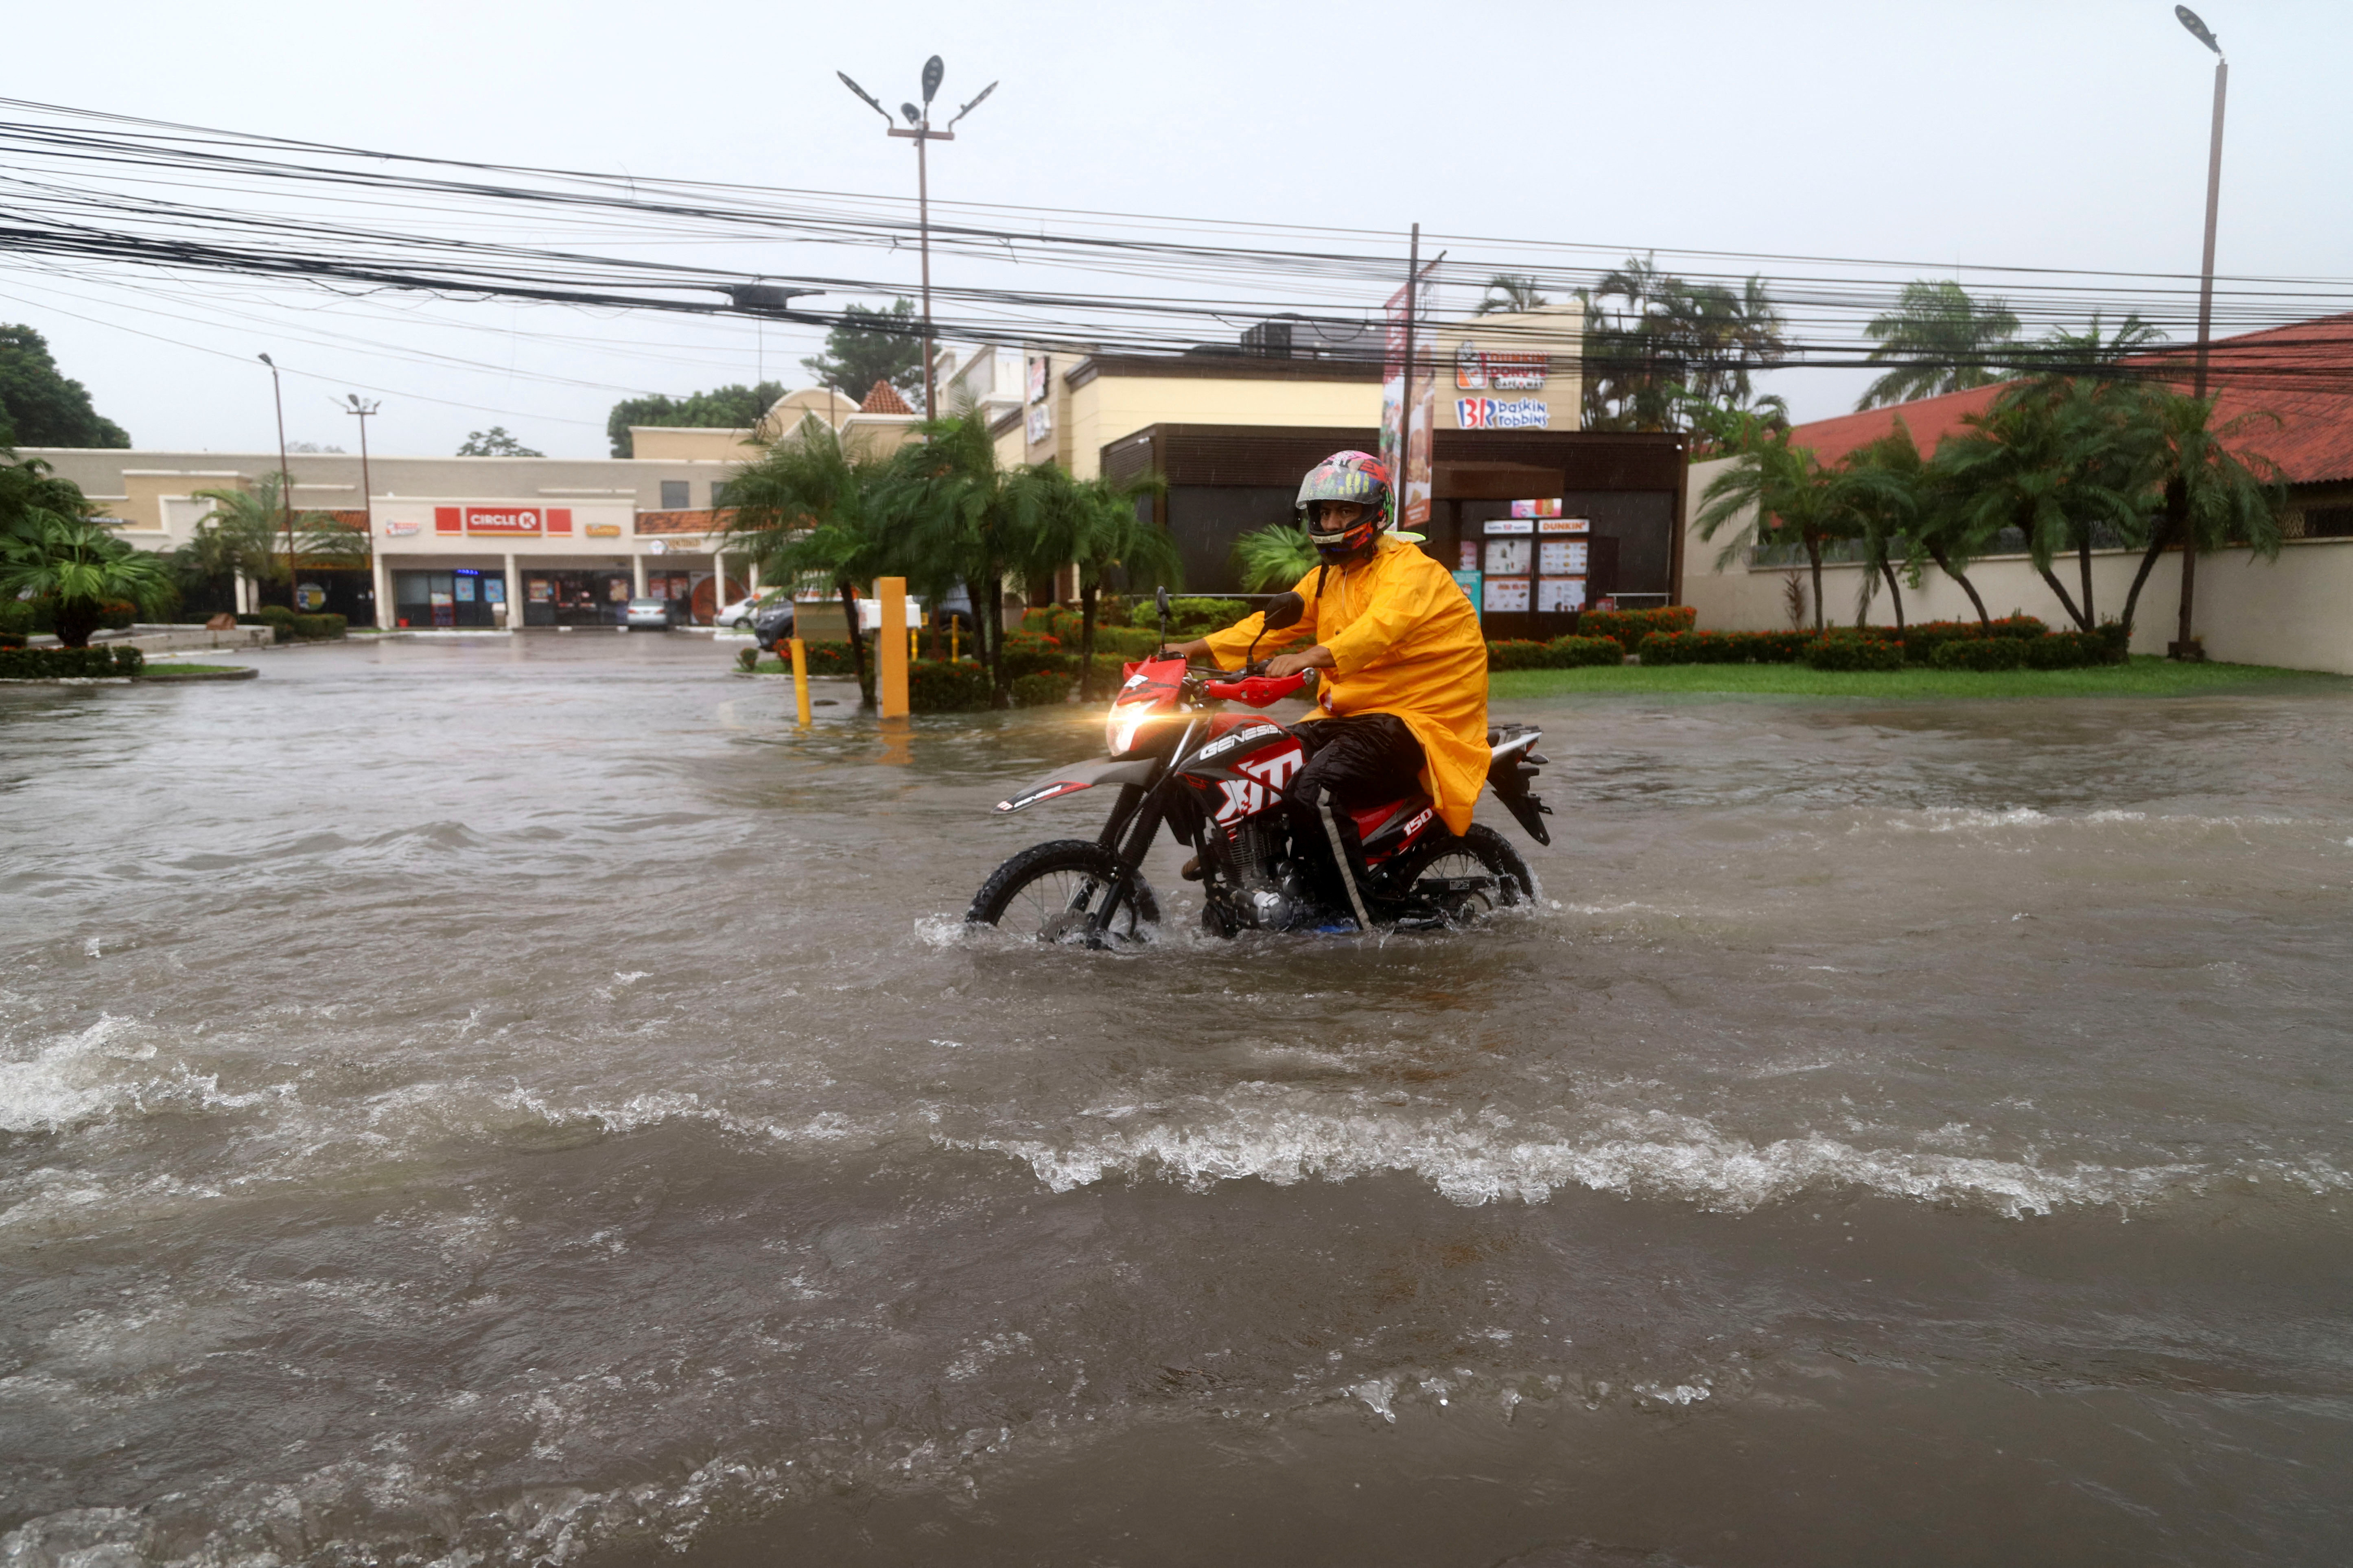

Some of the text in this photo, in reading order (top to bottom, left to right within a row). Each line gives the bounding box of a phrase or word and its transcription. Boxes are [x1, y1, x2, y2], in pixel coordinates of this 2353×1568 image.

[1458, 398, 1496, 427] BR
[470, 511, 537, 529] CIRCLE K
[1543, 522, 1585, 531] DUNKIN'
[1200, 724, 1279, 760] GENESIS
[1404, 808, 1433, 836] 150
